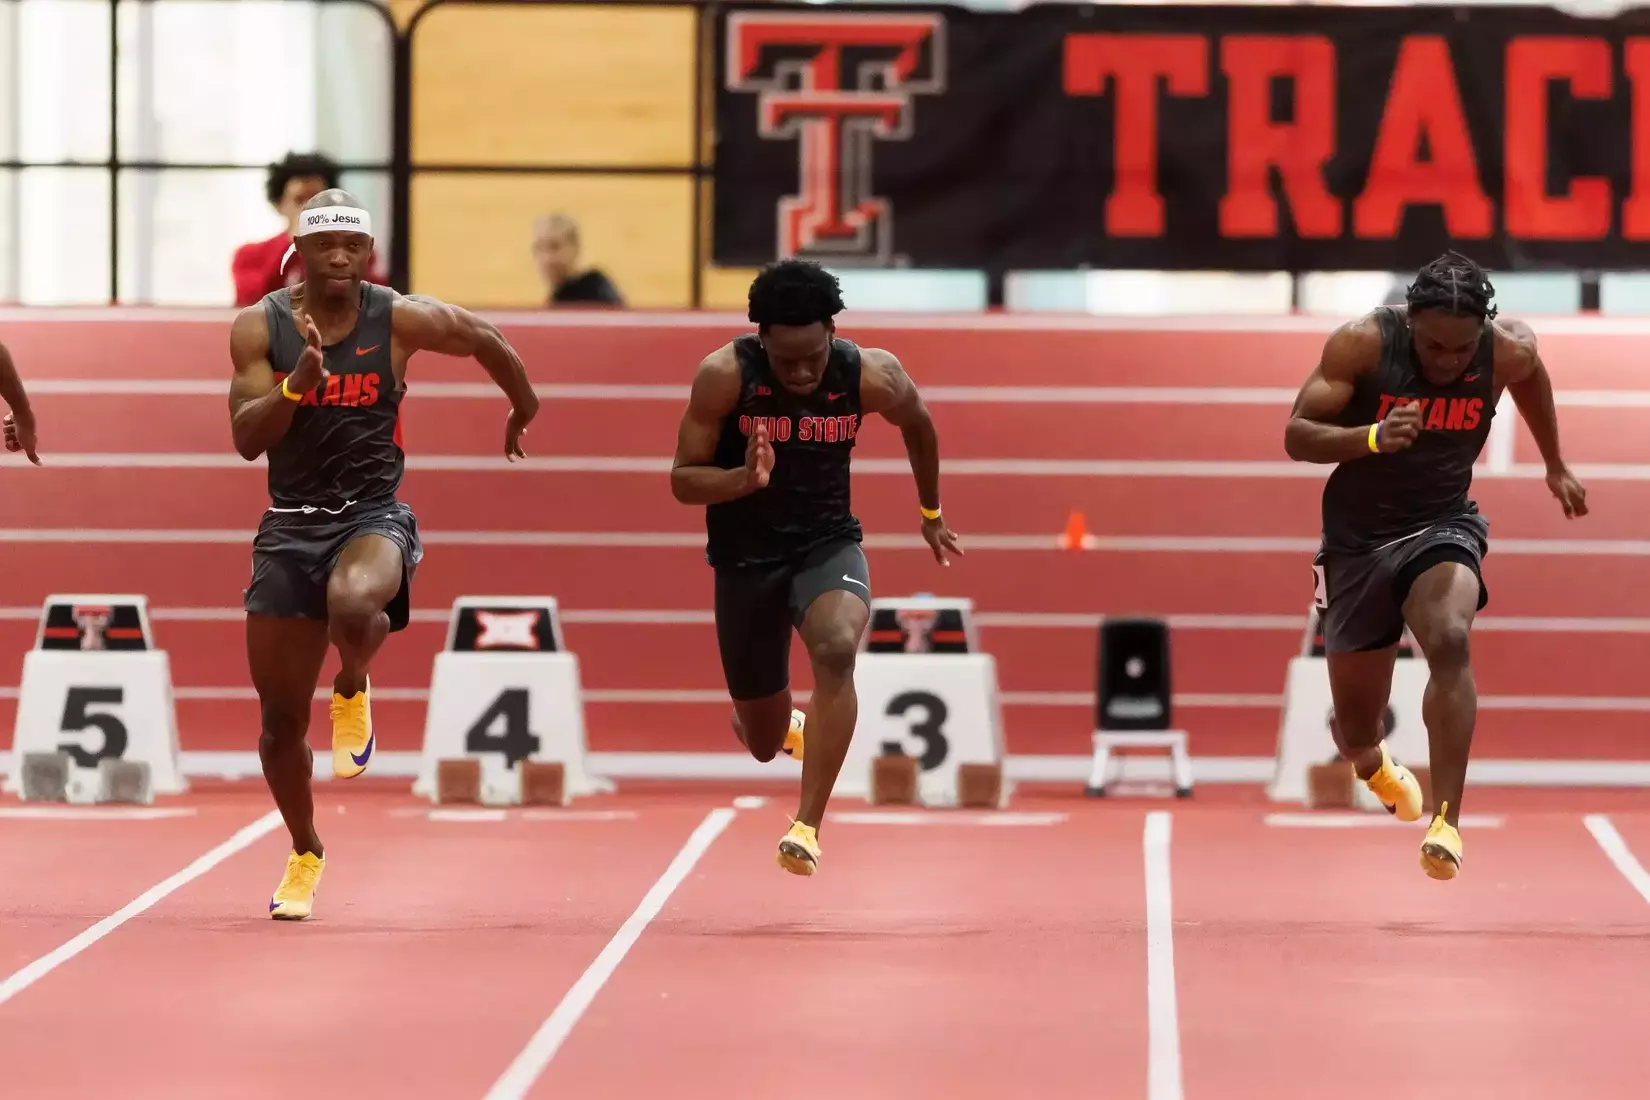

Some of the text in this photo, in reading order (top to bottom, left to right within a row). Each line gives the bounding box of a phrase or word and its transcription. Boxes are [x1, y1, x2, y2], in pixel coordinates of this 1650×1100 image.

[306, 213, 361, 226] 100% Jesus
[798, 413, 858, 442] STATE
[58, 686, 128, 768] 5
[465, 687, 540, 769] 4
[880, 689, 950, 771] 3
